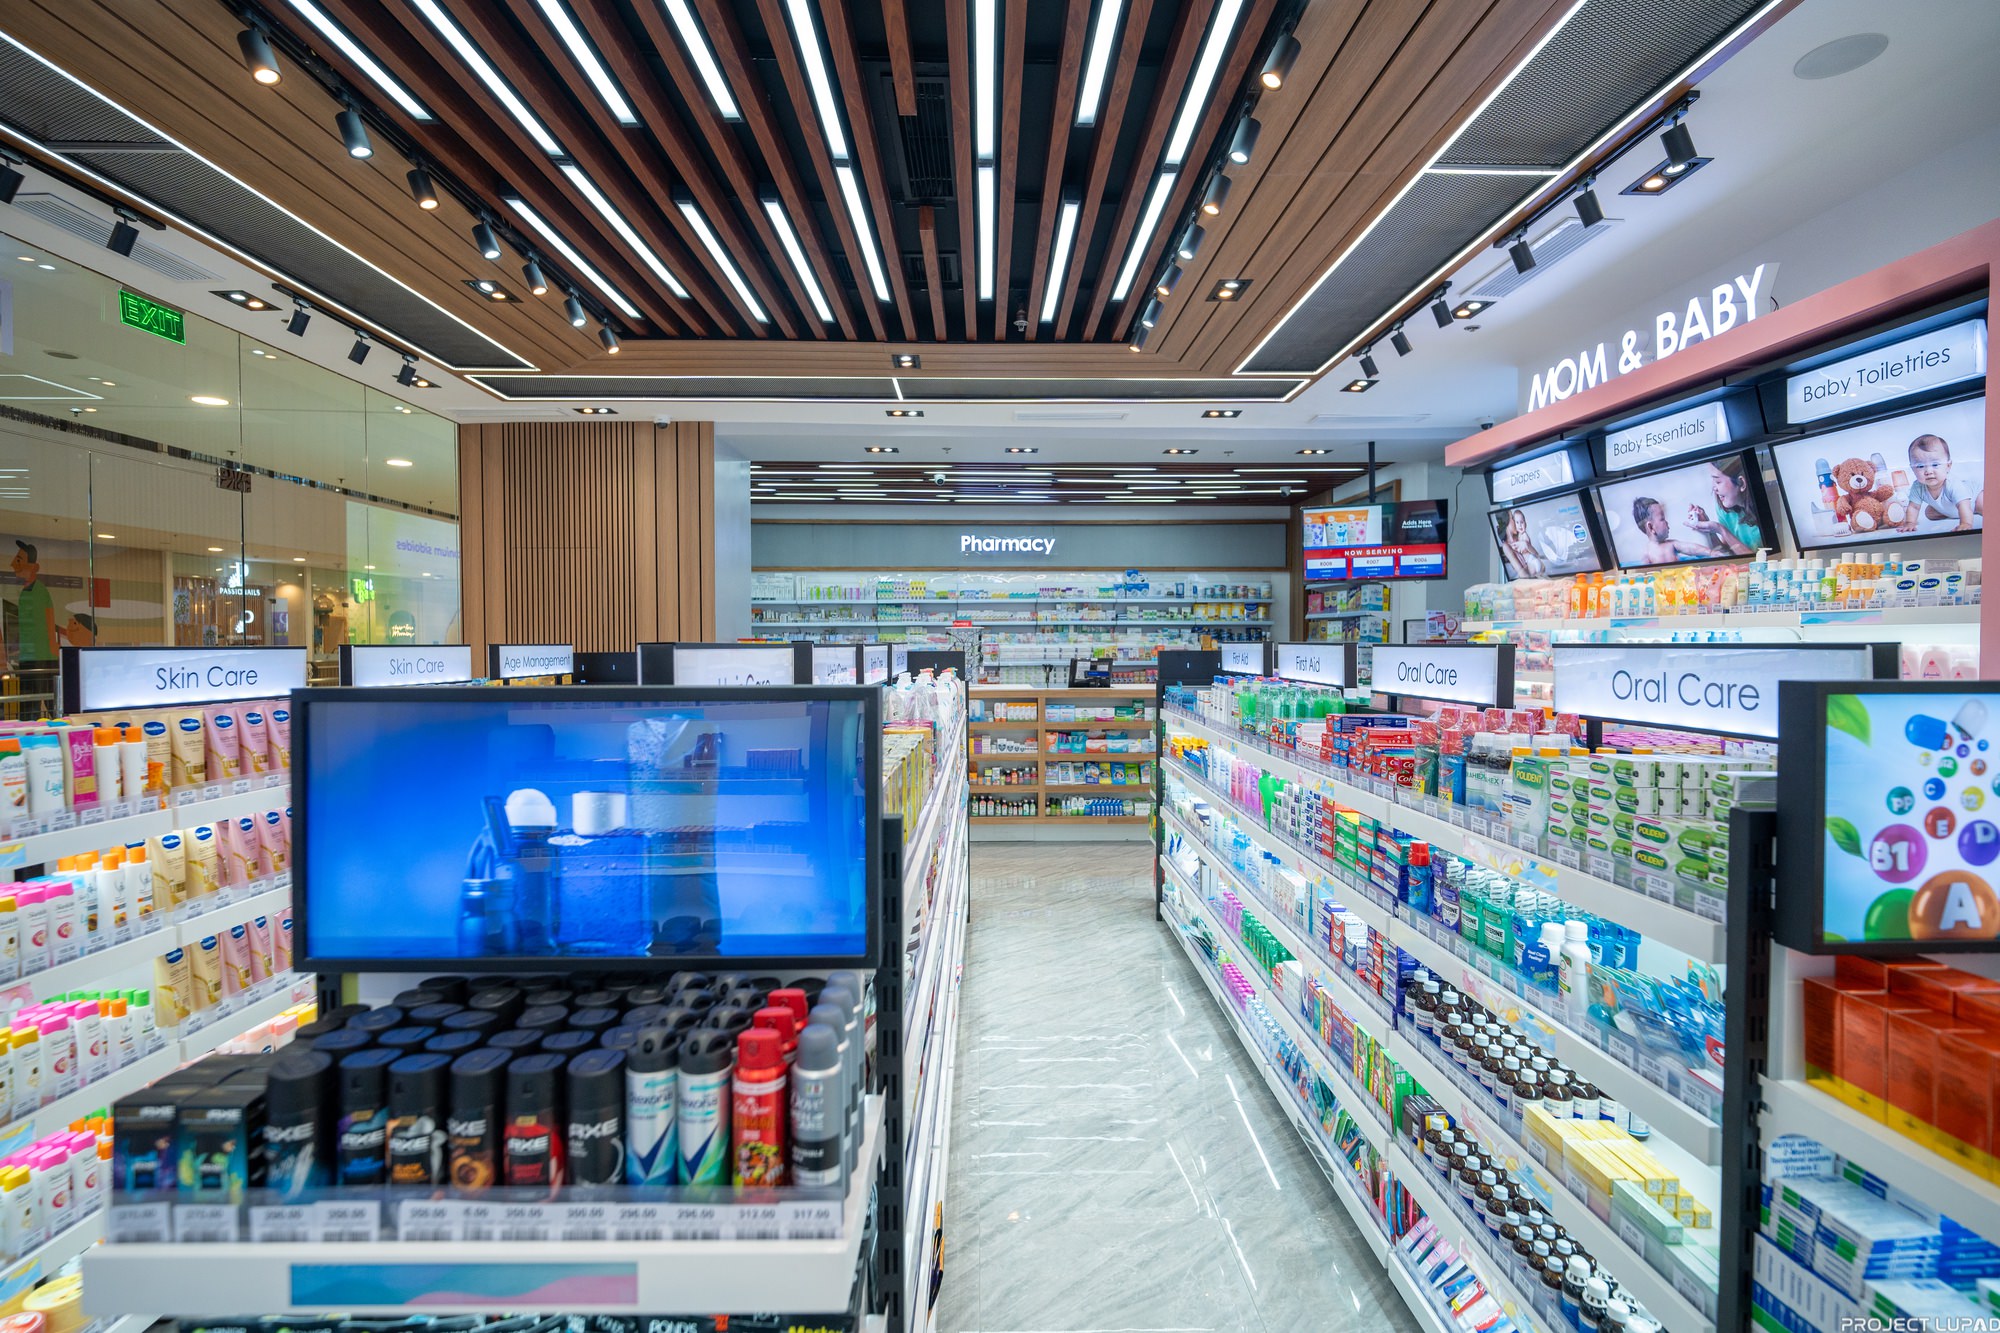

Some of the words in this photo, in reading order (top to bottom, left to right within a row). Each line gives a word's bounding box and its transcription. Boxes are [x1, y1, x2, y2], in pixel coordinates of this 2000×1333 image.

[124, 296, 180, 336] EXIT
[1527, 341, 1608, 413] MOM
[1618, 329, 1643, 375] &
[1656, 264, 1768, 357] BABY
[1803, 374, 1851, 403] Baby
[1856, 344, 1951, 387] Toiletries
[1613, 435, 1643, 457] Baby
[1646, 417, 1706, 446] Essentials
[1510, 467, 1541, 487] Diapers
[961, 535, 1056, 554] Pharmacy
[1920, 579, 1938, 588] Cetaphil
[390, 657, 413, 675] Skin
[416, 658, 444, 673] Care
[504, 656, 521, 670] Age
[522, 655, 571, 669] Management
[1232, 652, 1241, 665] First
[1241, 653, 1249, 666] Aid
[1296, 656, 1308, 672] First
[1309, 657, 1321, 673] Aid
[155, 666, 199, 690] Skin
[207, 666, 258, 689] Care
[1397, 661, 1422, 683] Oral
[1425, 663, 1458, 686] Care
[1612, 670, 1667, 704] Oral
[1677, 673, 1760, 710] Care
[1516, 769, 1544, 785] POLIDENT
[1925, 783, 1936, 796] C
[1892, 796, 1914, 812] PP
[1638, 825, 1667, 841] POLIDENT
[1936, 819, 1948, 836] E
[1975, 823, 1997, 844] D
[1637, 851, 1666, 868] POLIDENT
[1872, 840, 1909, 872] B1
[1939, 882, 1982, 930] A
[139, 1105, 177, 1118] AXE
[206, 1109, 242, 1121] AXE
[263, 1121, 315, 1143] AXE
[342, 1128, 386, 1147] AXE
[569, 1117, 619, 1140] AXE
[390, 1135, 430, 1152] AXE
[508, 1135, 549, 1152] AXE
